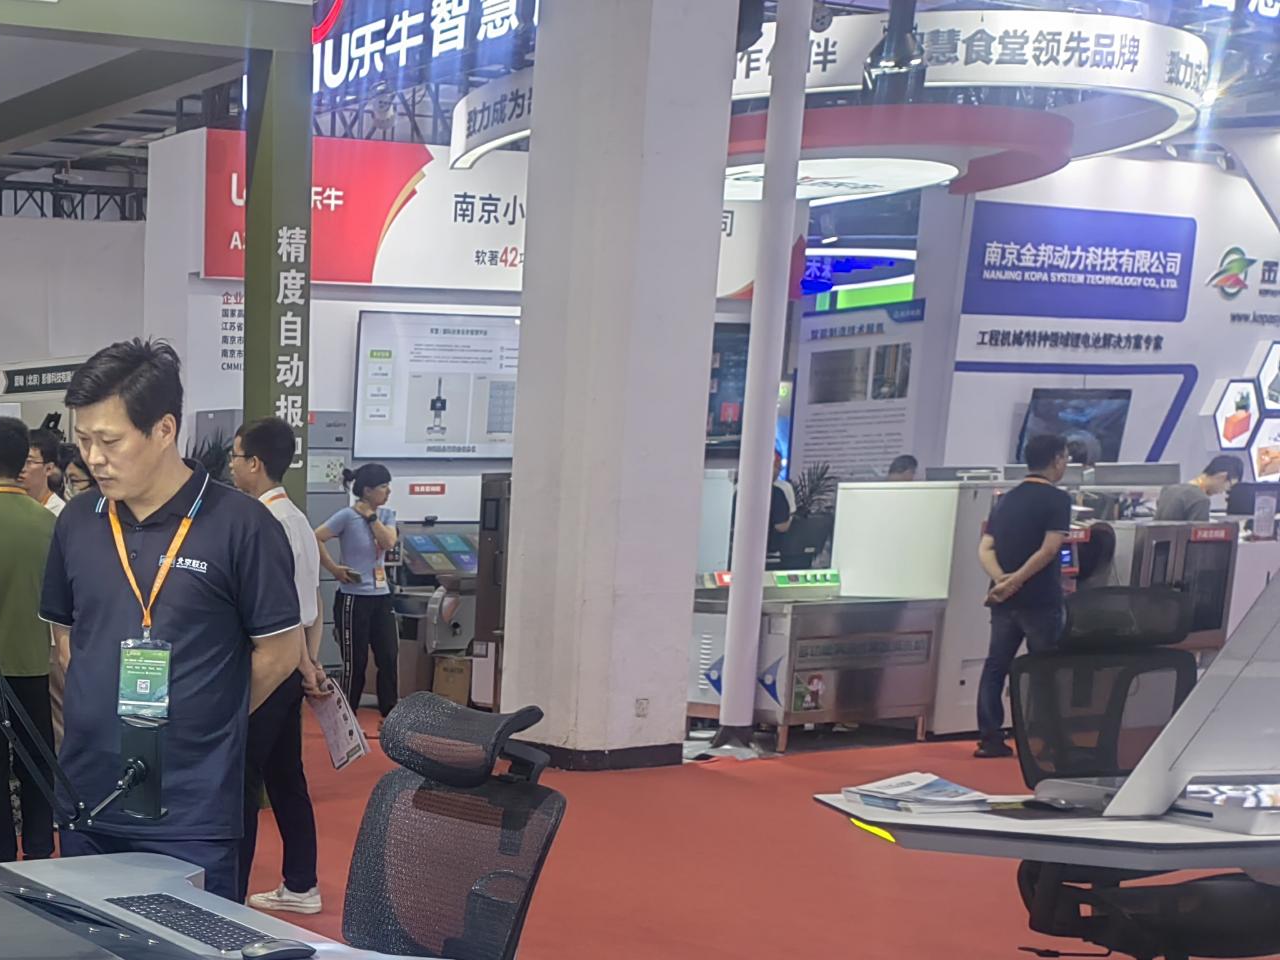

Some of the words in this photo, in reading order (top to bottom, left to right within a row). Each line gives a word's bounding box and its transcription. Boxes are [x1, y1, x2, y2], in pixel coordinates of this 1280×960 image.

[911, 28, 1141, 73] 慧食堂领先品牌
[466, 87, 533, 139] 致力成为
[982, 270, 1022, 281] NANJING
[1024, 271, 1049, 282] KOPA
[1050, 272, 1085, 285] SYSTEM
[984, 241, 1182, 276] 南京金邦动力科技有限公司
[275, 225, 308, 469] 精度自动报
